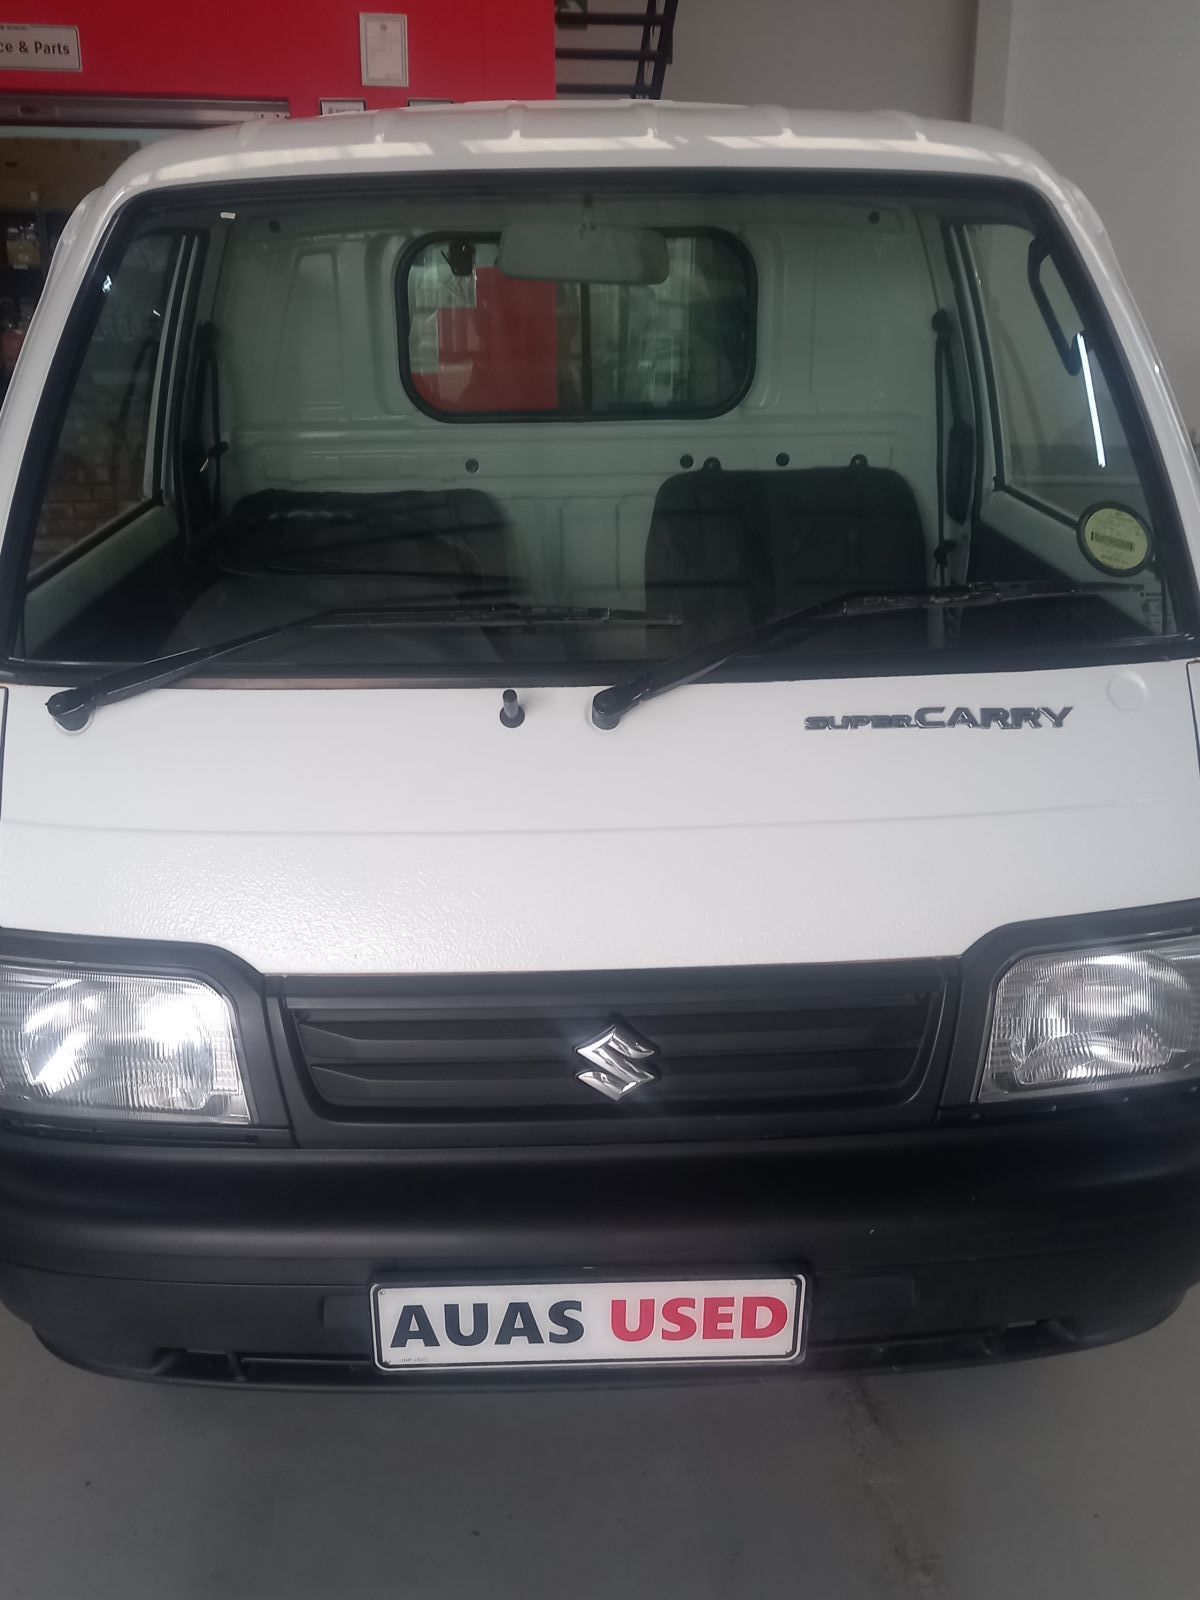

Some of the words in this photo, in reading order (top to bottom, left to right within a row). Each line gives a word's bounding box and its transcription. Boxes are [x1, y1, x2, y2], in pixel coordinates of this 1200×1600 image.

[19, 41, 29, 54] &
[34, 41, 70, 55] Parts
[390, 1300, 585, 1348] AUAS
[610, 1296, 788, 1343] USED
